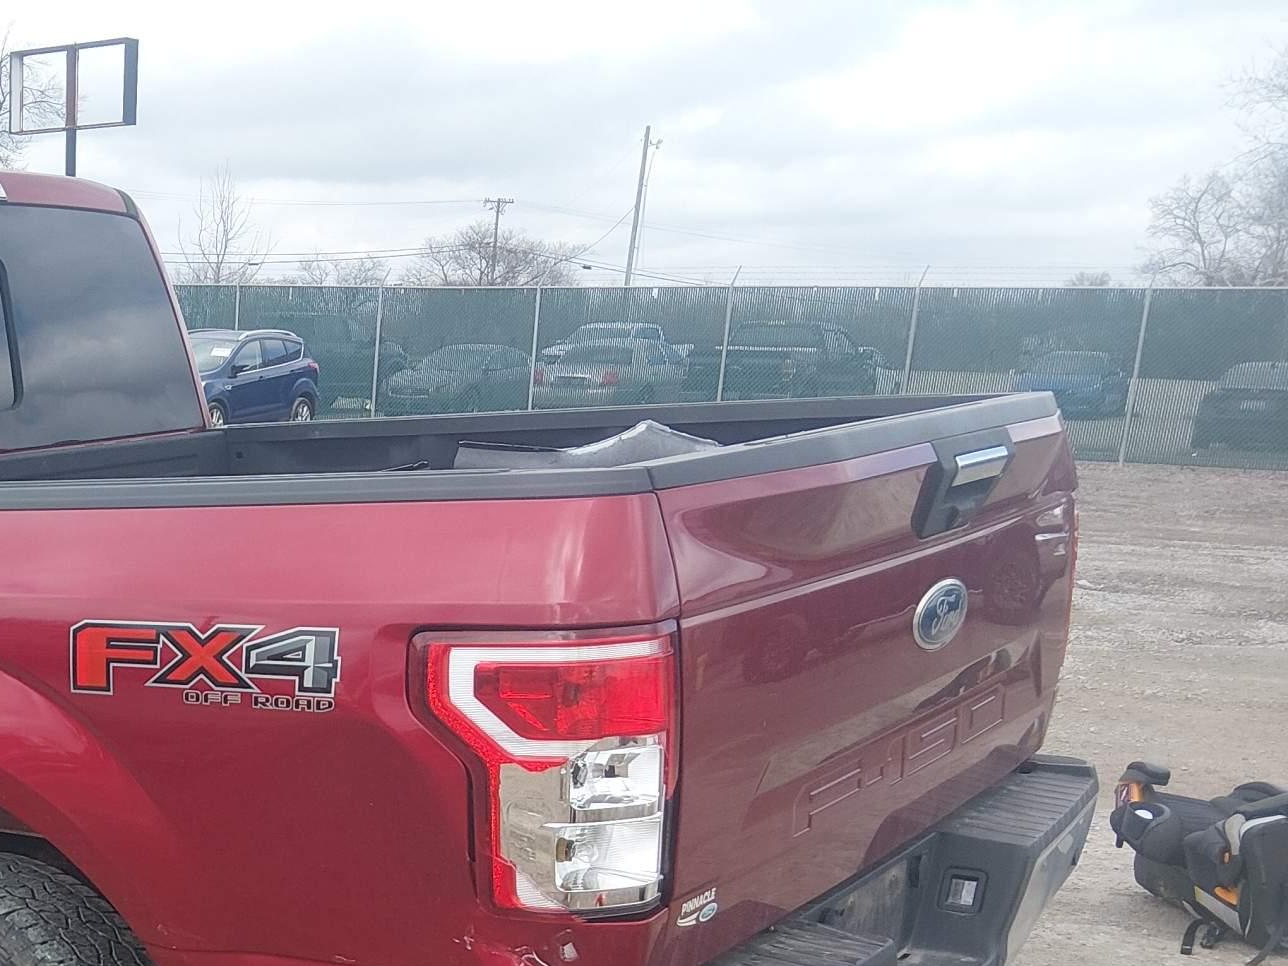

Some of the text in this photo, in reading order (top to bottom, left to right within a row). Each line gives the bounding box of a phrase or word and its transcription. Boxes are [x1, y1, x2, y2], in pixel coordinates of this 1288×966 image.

[70, 619, 341, 698] FX4
[183, 690, 335, 713] OFF ROAD
[681, 887, 717, 916] PINNACLE
